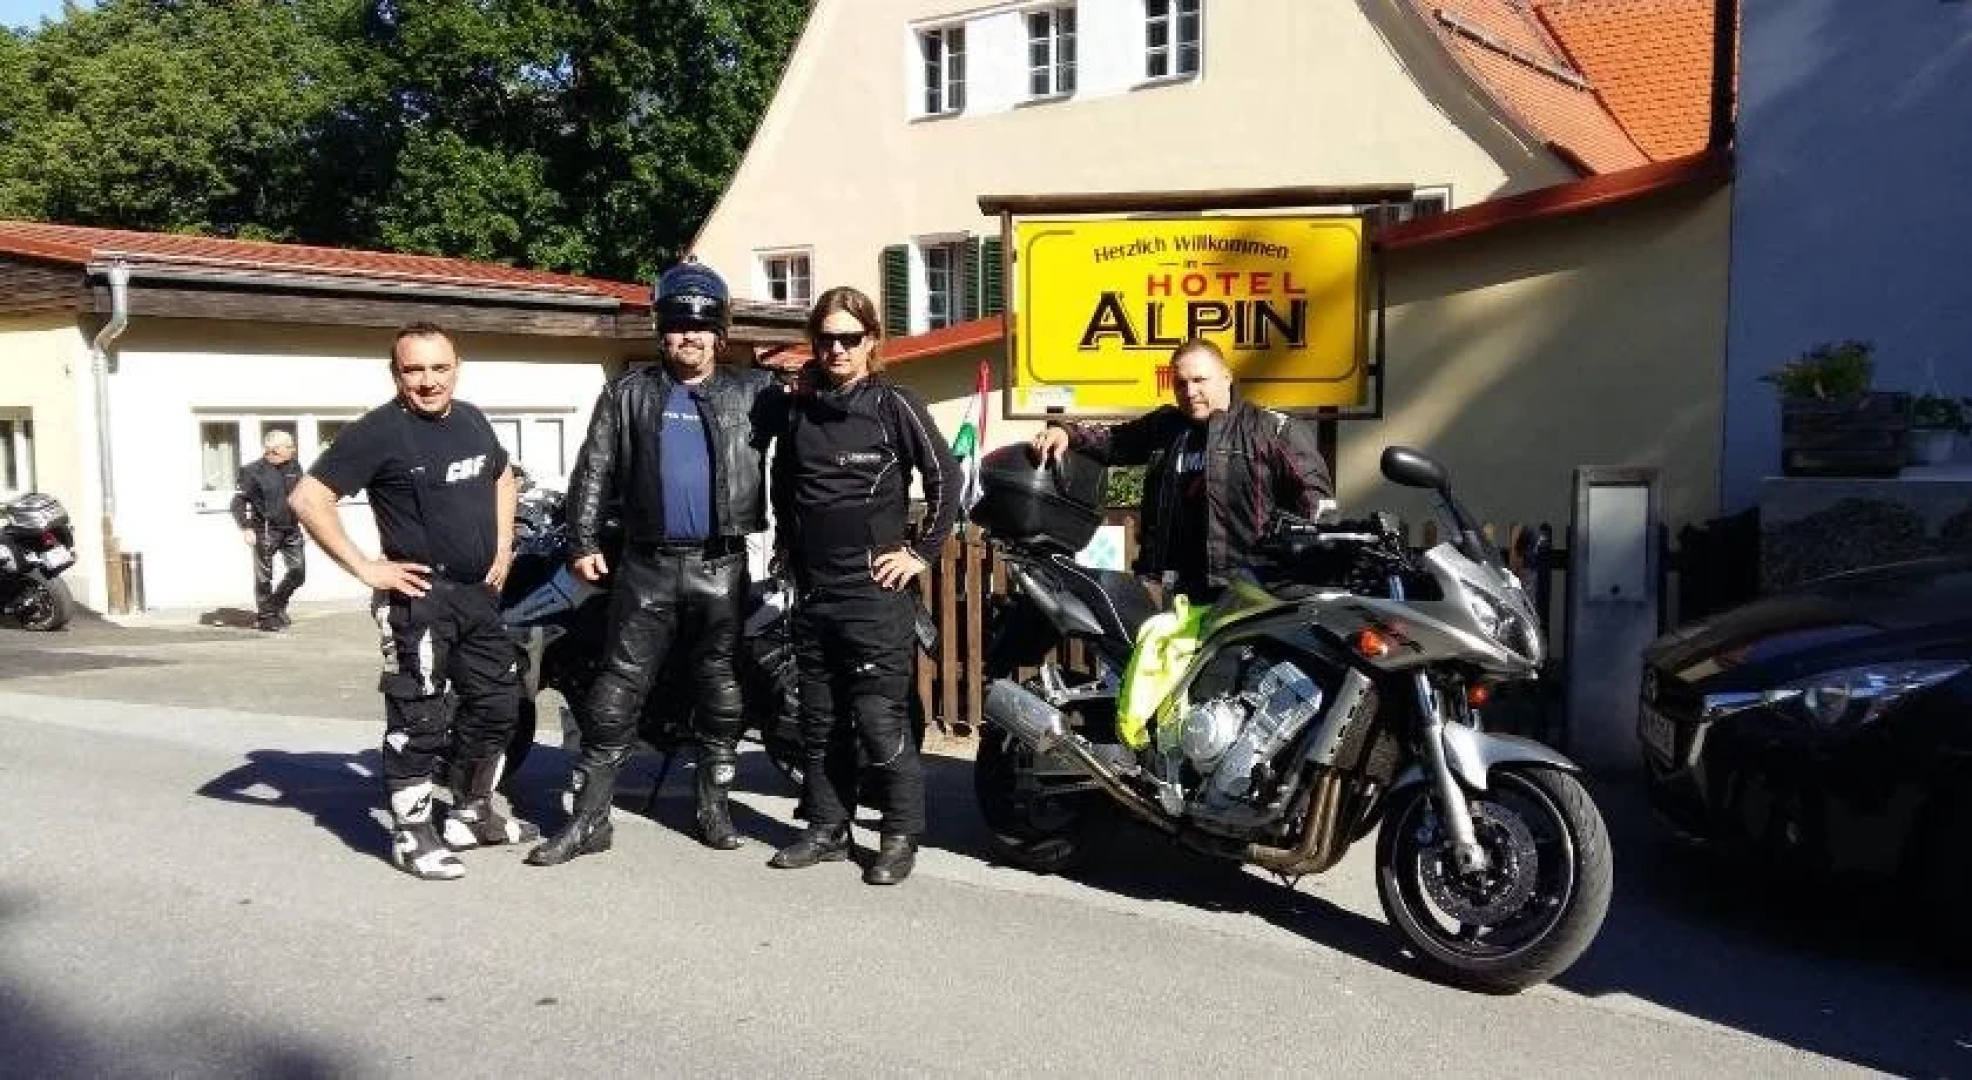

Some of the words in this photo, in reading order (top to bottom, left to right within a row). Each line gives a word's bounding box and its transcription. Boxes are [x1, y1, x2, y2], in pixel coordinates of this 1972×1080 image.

[1093, 238, 1167, 263] Herzlich
[1173, 234, 1288, 259] Willkommen
[1147, 272, 1305, 296] HOTEL
[1078, 290, 1308, 350] ALPIN
